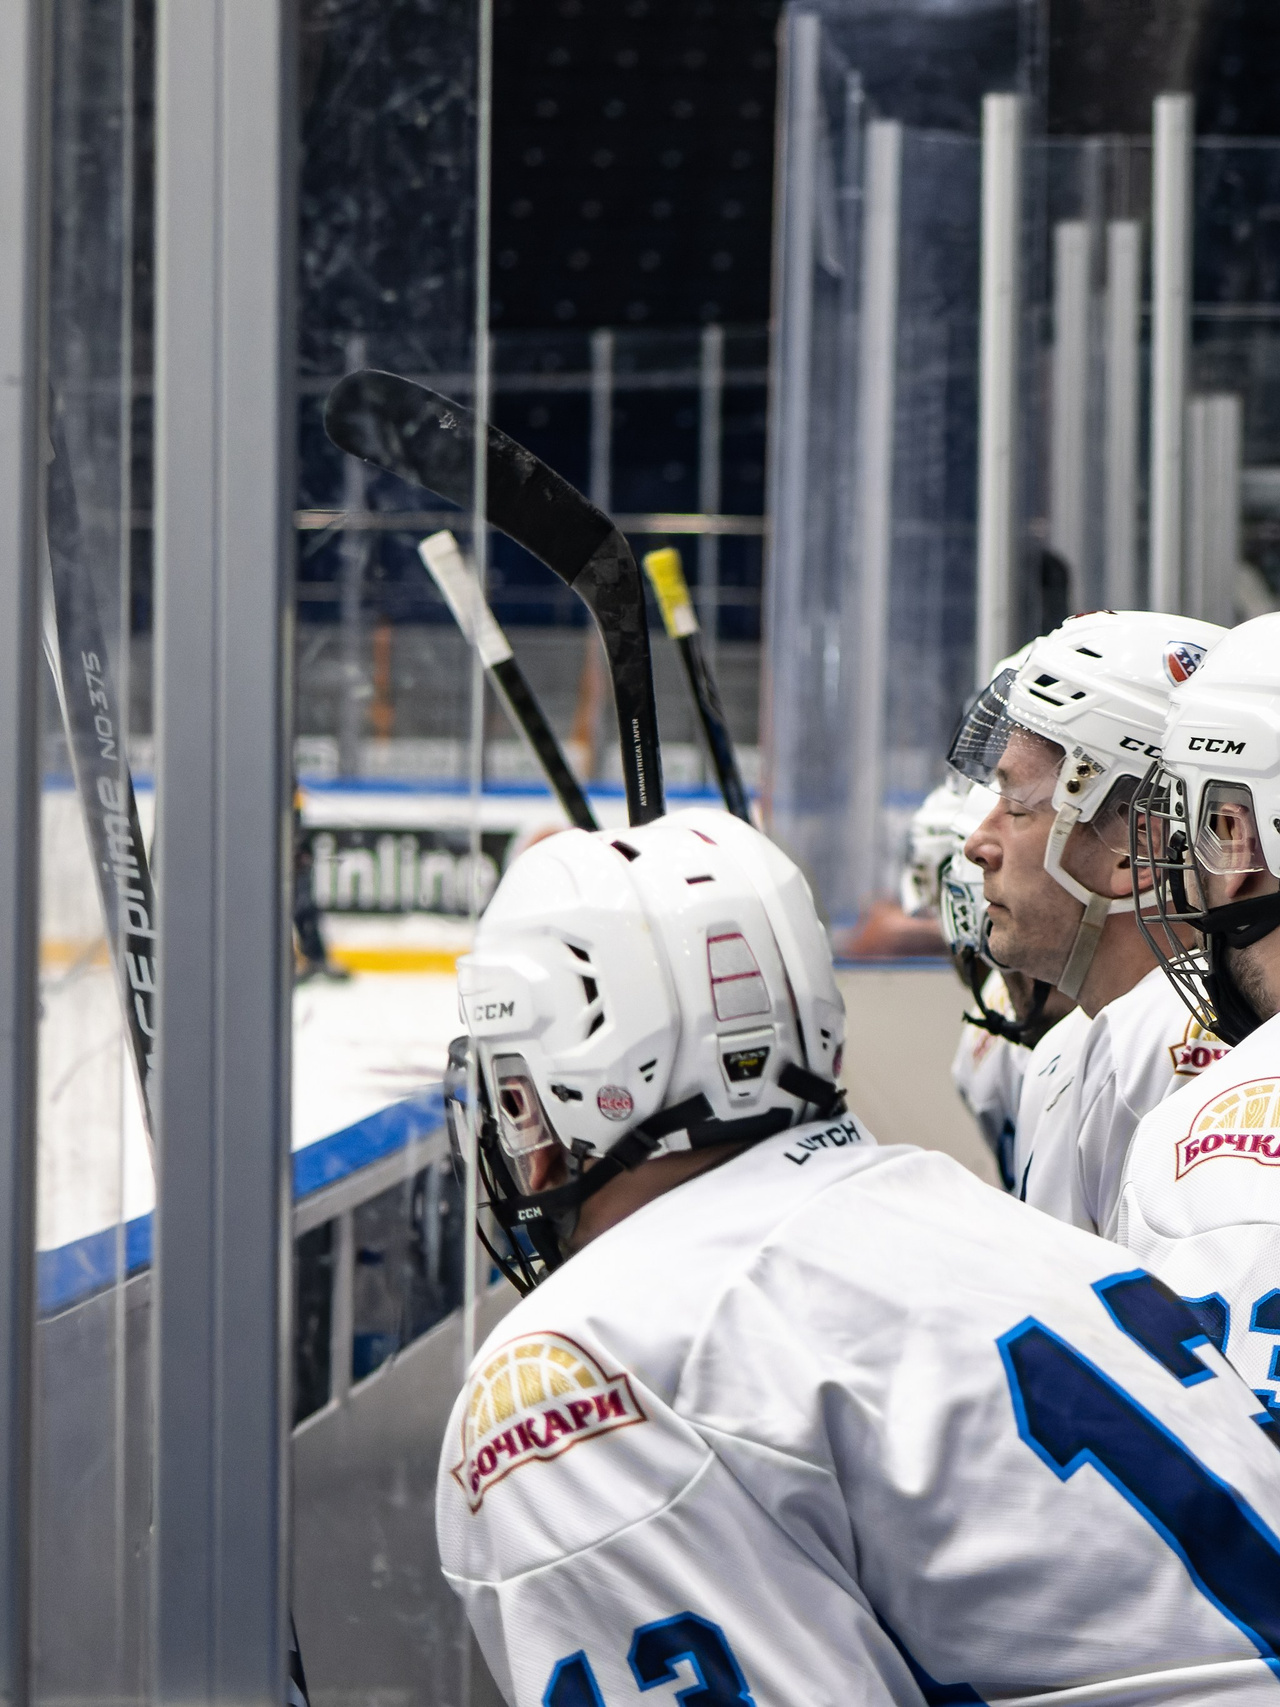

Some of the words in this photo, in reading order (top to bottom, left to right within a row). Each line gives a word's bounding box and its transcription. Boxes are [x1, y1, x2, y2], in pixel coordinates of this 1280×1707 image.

[632, 718, 641, 742] TAPER
[1188, 736, 1247, 755] CCM
[97, 774, 157, 938] prime
[474, 1001, 516, 1021] CCM
[783, 1120, 862, 1166] LUTCH
[518, 1207, 543, 1221] CCM
[470, 1389, 628, 1495] БОЧКАРИ
